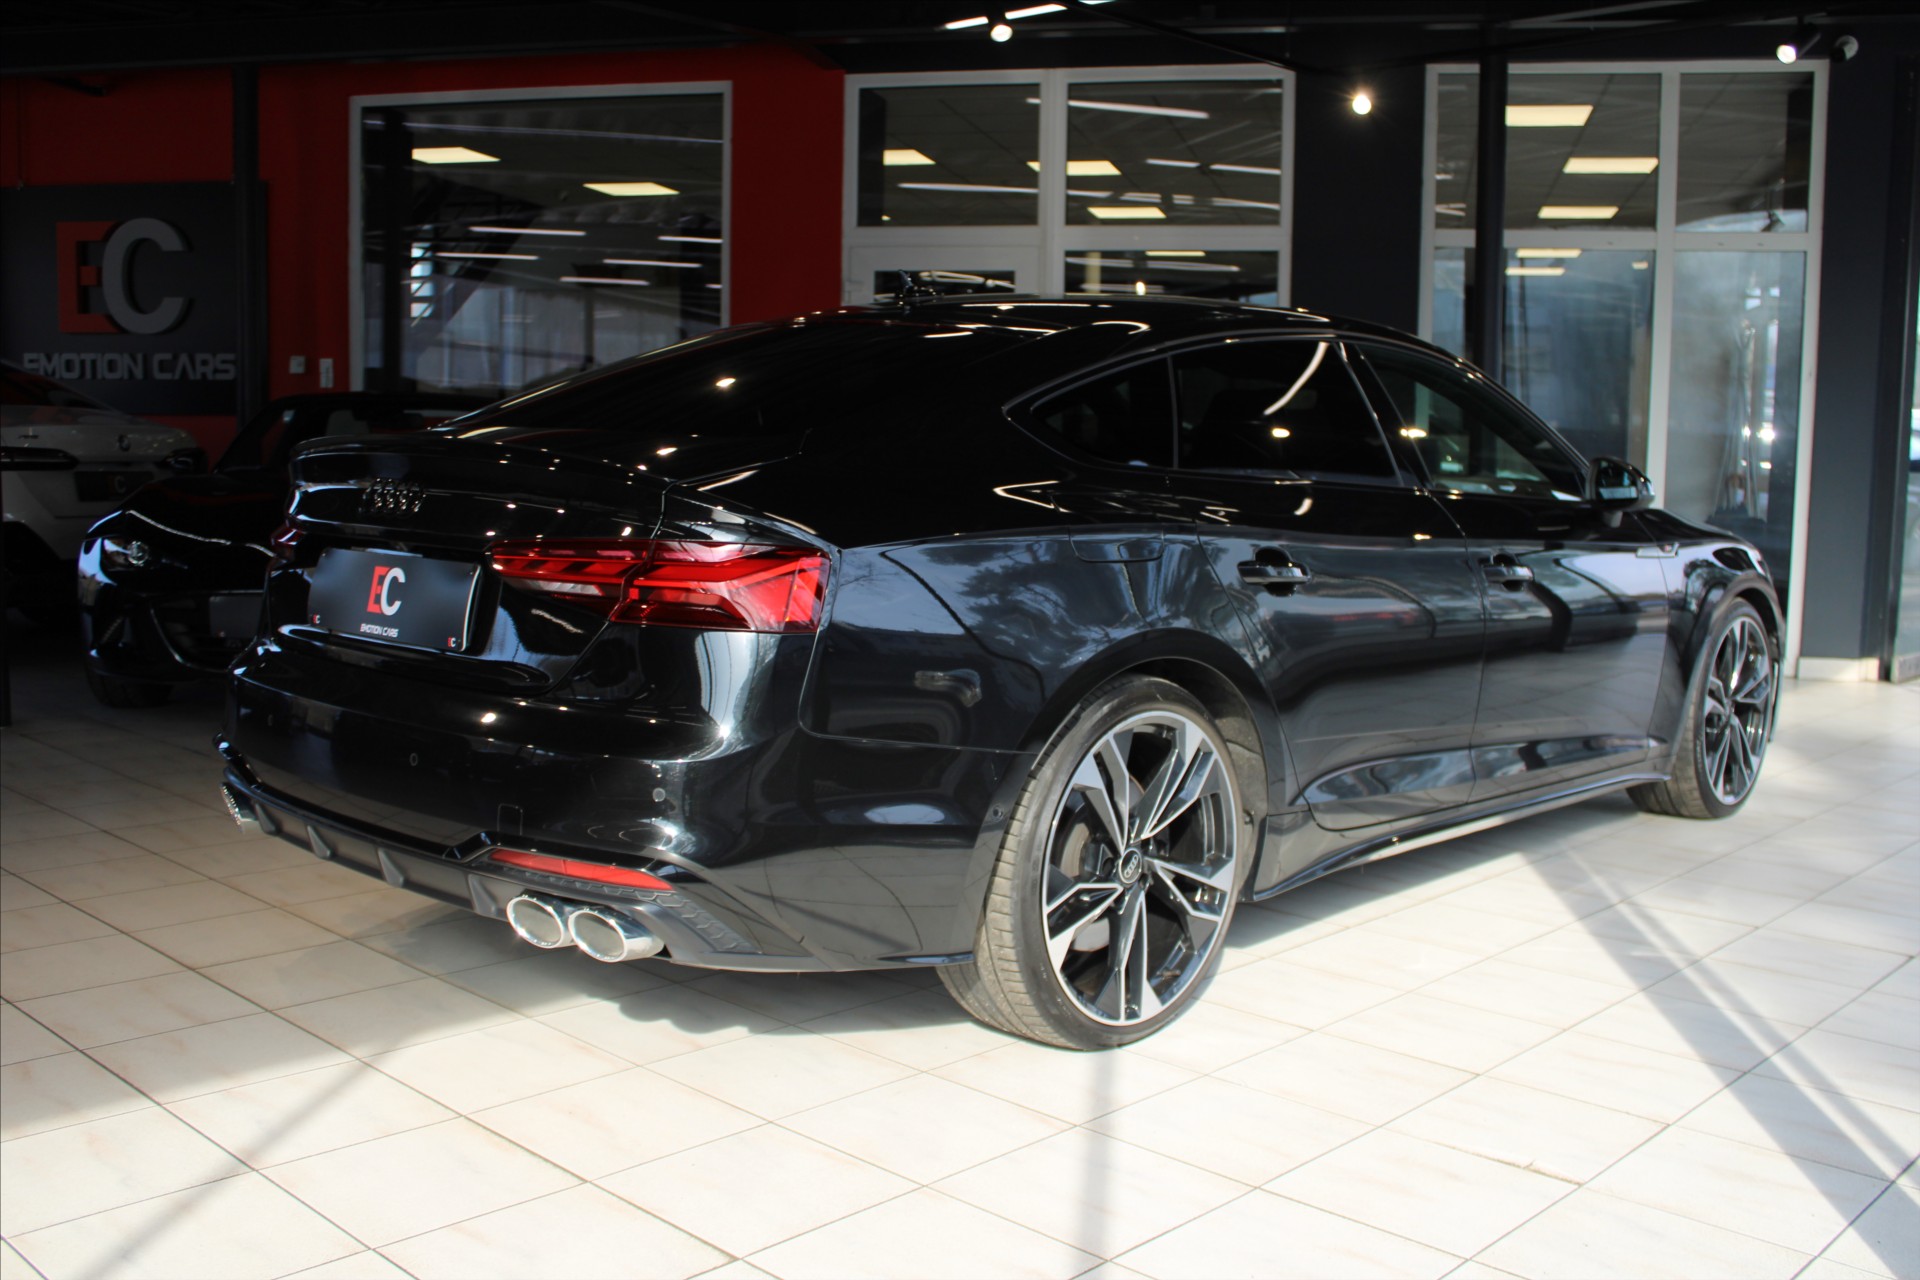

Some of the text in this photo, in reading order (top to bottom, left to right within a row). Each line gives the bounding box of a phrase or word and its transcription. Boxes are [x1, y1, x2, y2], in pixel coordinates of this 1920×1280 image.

[56, 217, 190, 335] EC
[23, 352, 237, 381] EMOTION CARS
[367, 565, 406, 616] EC
[382, 626, 399, 638] CARS
